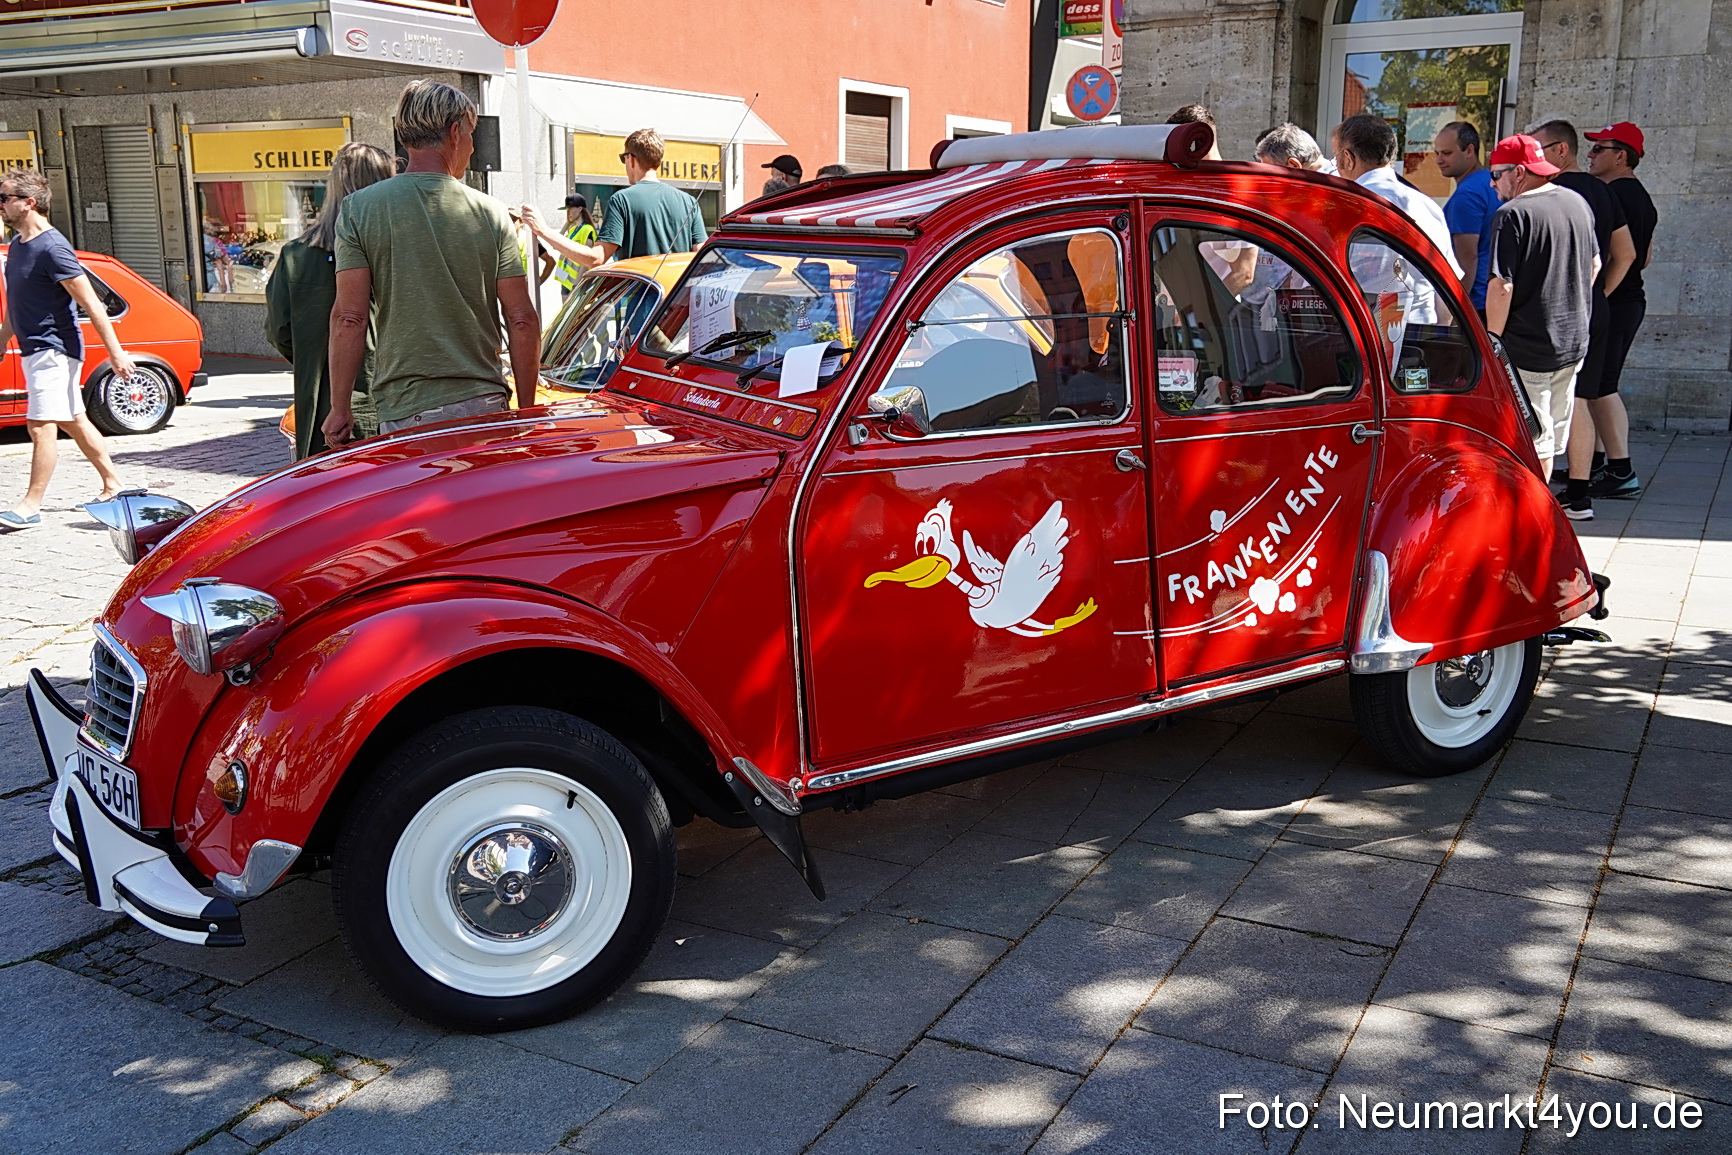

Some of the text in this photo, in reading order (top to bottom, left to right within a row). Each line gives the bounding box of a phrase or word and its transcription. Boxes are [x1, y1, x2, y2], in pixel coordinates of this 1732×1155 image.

[1067, 4, 1100, 14] dess
[254, 150, 333, 169] SCHLIER
[660, 161, 719, 179] HLIERF
[709, 285, 729, 308] 330
[100, 763, 136, 821] 56H
